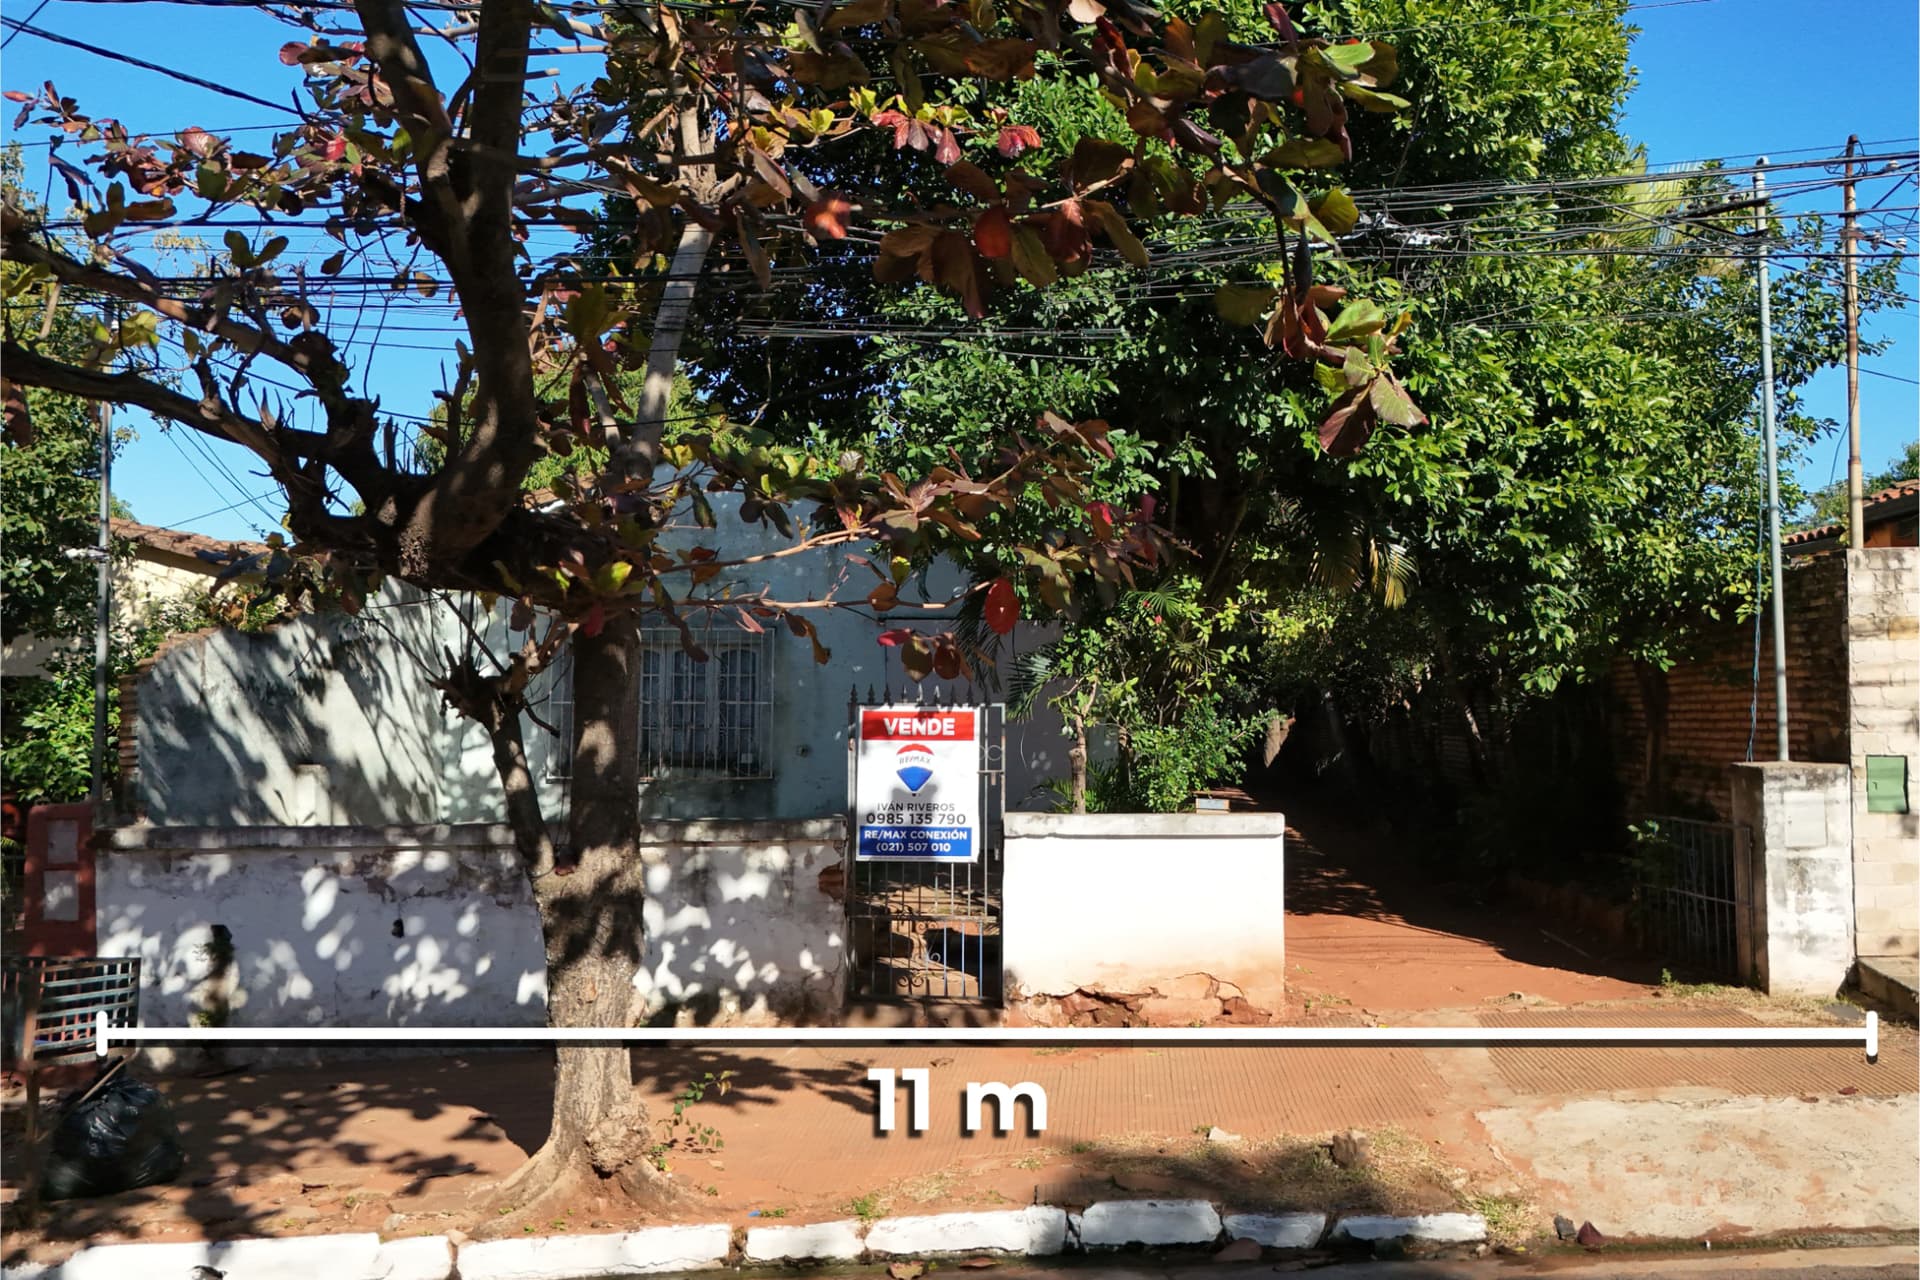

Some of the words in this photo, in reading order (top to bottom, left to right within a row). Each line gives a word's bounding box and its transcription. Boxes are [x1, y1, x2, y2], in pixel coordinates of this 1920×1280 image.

[883, 718, 956, 736] VENDE
[899, 756, 931, 765] RE/MAX
[907, 803, 955, 811] RIVEROS
[866, 813, 904, 825] 0985
[910, 813, 933, 825] 135
[938, 813, 966, 824] 790
[864, 830, 907, 839] RE/MAX
[910, 829, 967, 840] CONEXIÓN
[876, 842, 904, 852] (021)
[907, 843, 928, 851] 507
[931, 843, 951, 851] 010
